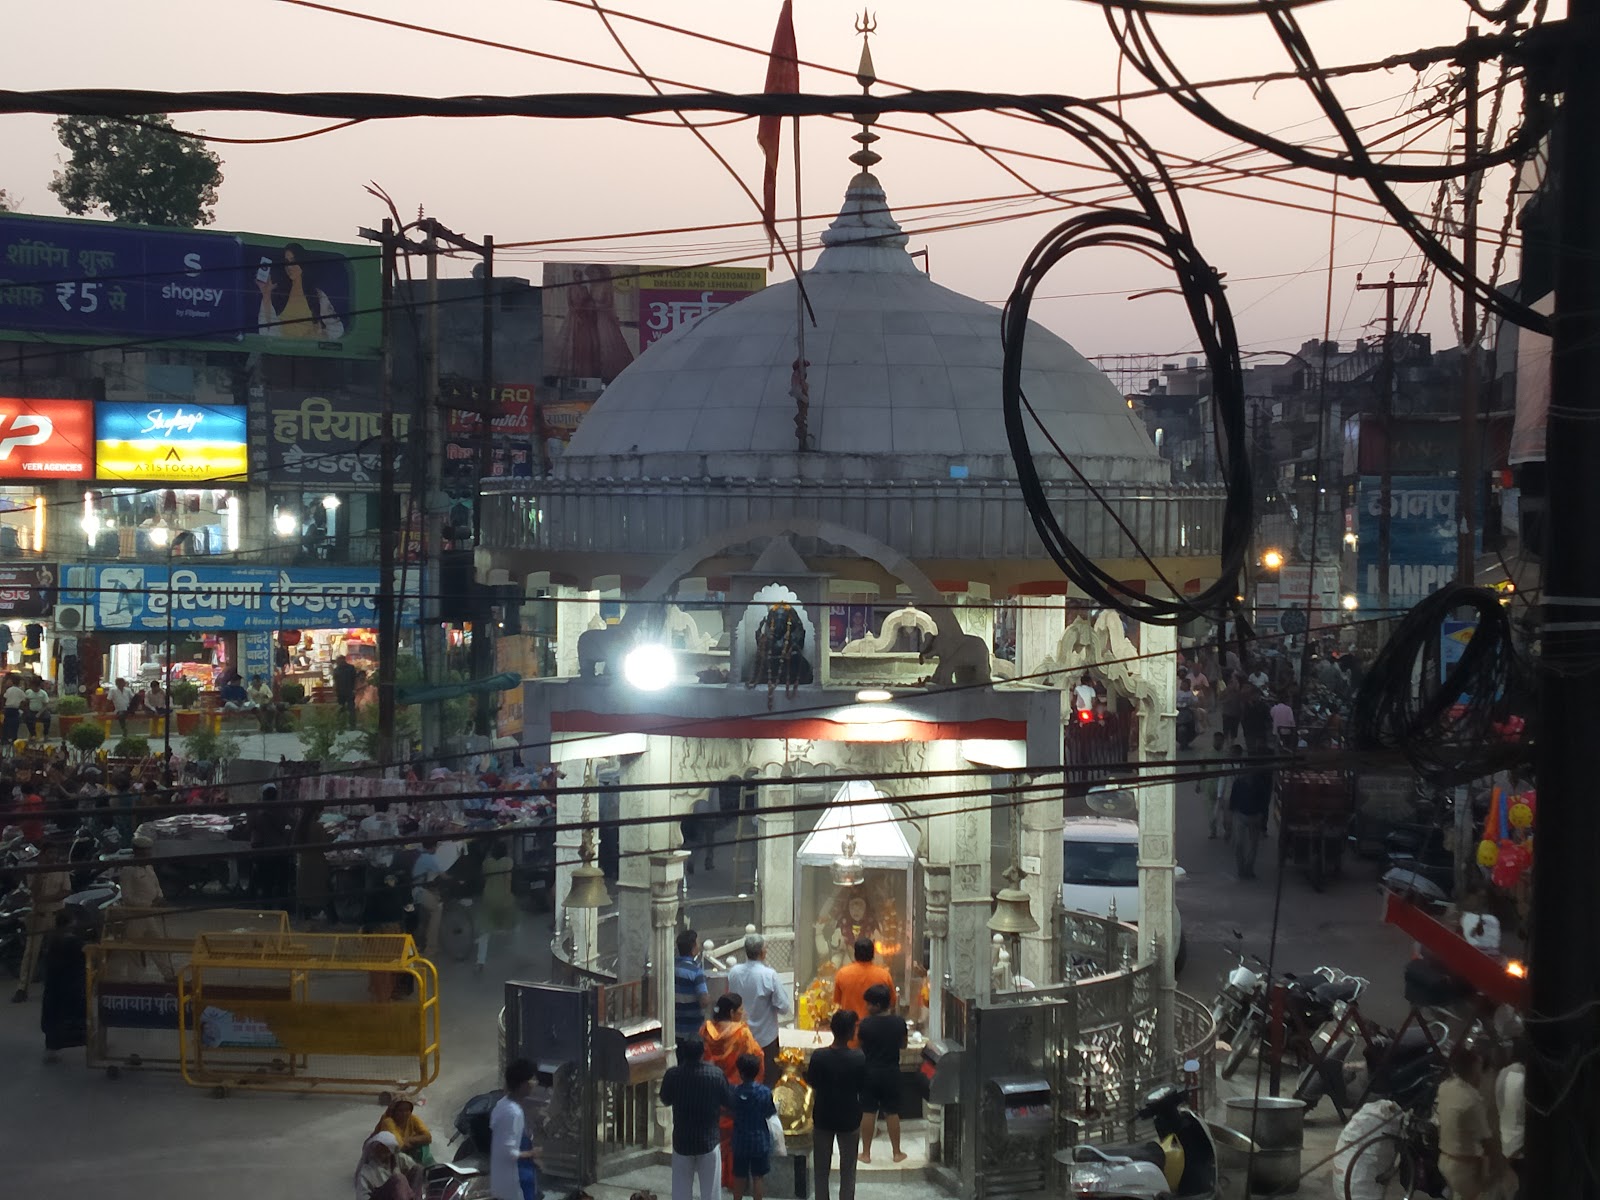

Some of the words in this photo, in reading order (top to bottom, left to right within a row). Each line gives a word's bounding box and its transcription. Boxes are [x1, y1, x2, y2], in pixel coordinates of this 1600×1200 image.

[665, 270, 690, 279] FLOOR
[693, 271, 709, 279] FOR
[711, 272, 761, 281] CUSTOMIZED
[653, 280, 686, 288] DRESSES
[687, 280, 705, 289] AND
[707, 280, 748, 289] LEHENGAS
[161, 282, 223, 306] shopsy
[22, 463, 43, 471] VEER
[44, 463, 83, 472] AGENCIES
[134, 463, 210, 473] ARISTOCRAT
[146, 570, 262, 613] हरियाणा
